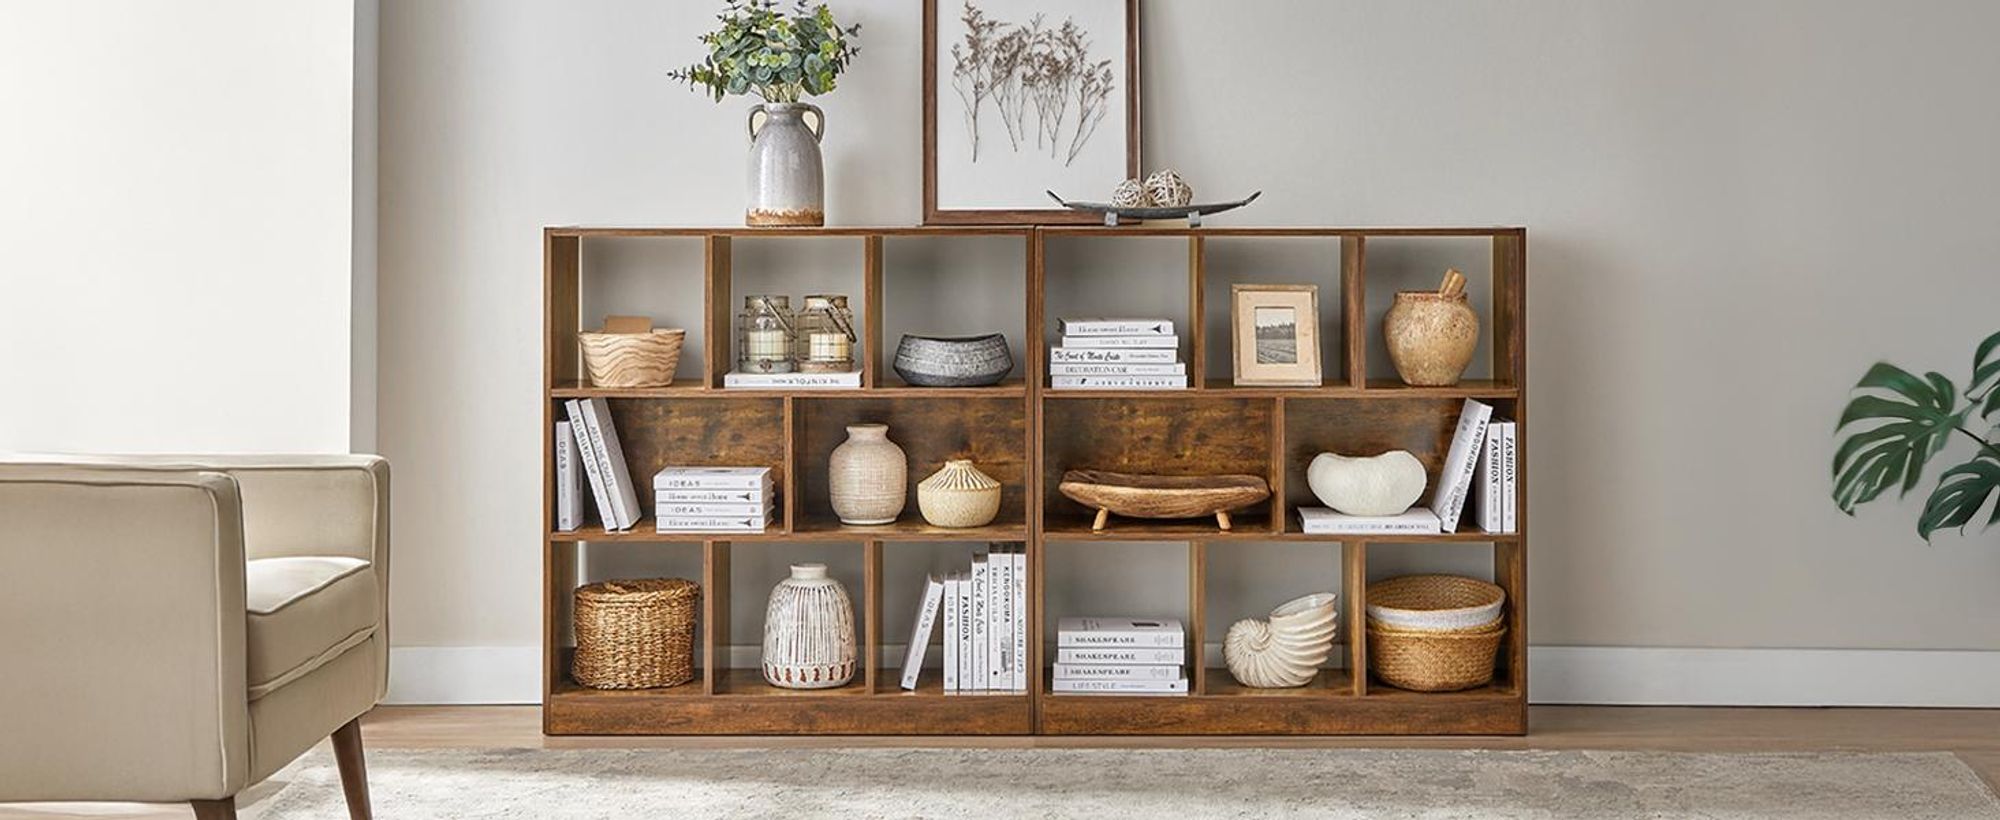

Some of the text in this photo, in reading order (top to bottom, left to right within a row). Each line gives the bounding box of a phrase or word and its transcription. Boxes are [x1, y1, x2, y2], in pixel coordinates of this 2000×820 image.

[1491, 438, 1499, 484] FASHION
[1505, 437, 1514, 482] FASHION
[921, 597, 936, 629] IDEAS
[961, 595, 969, 641] FASHION
